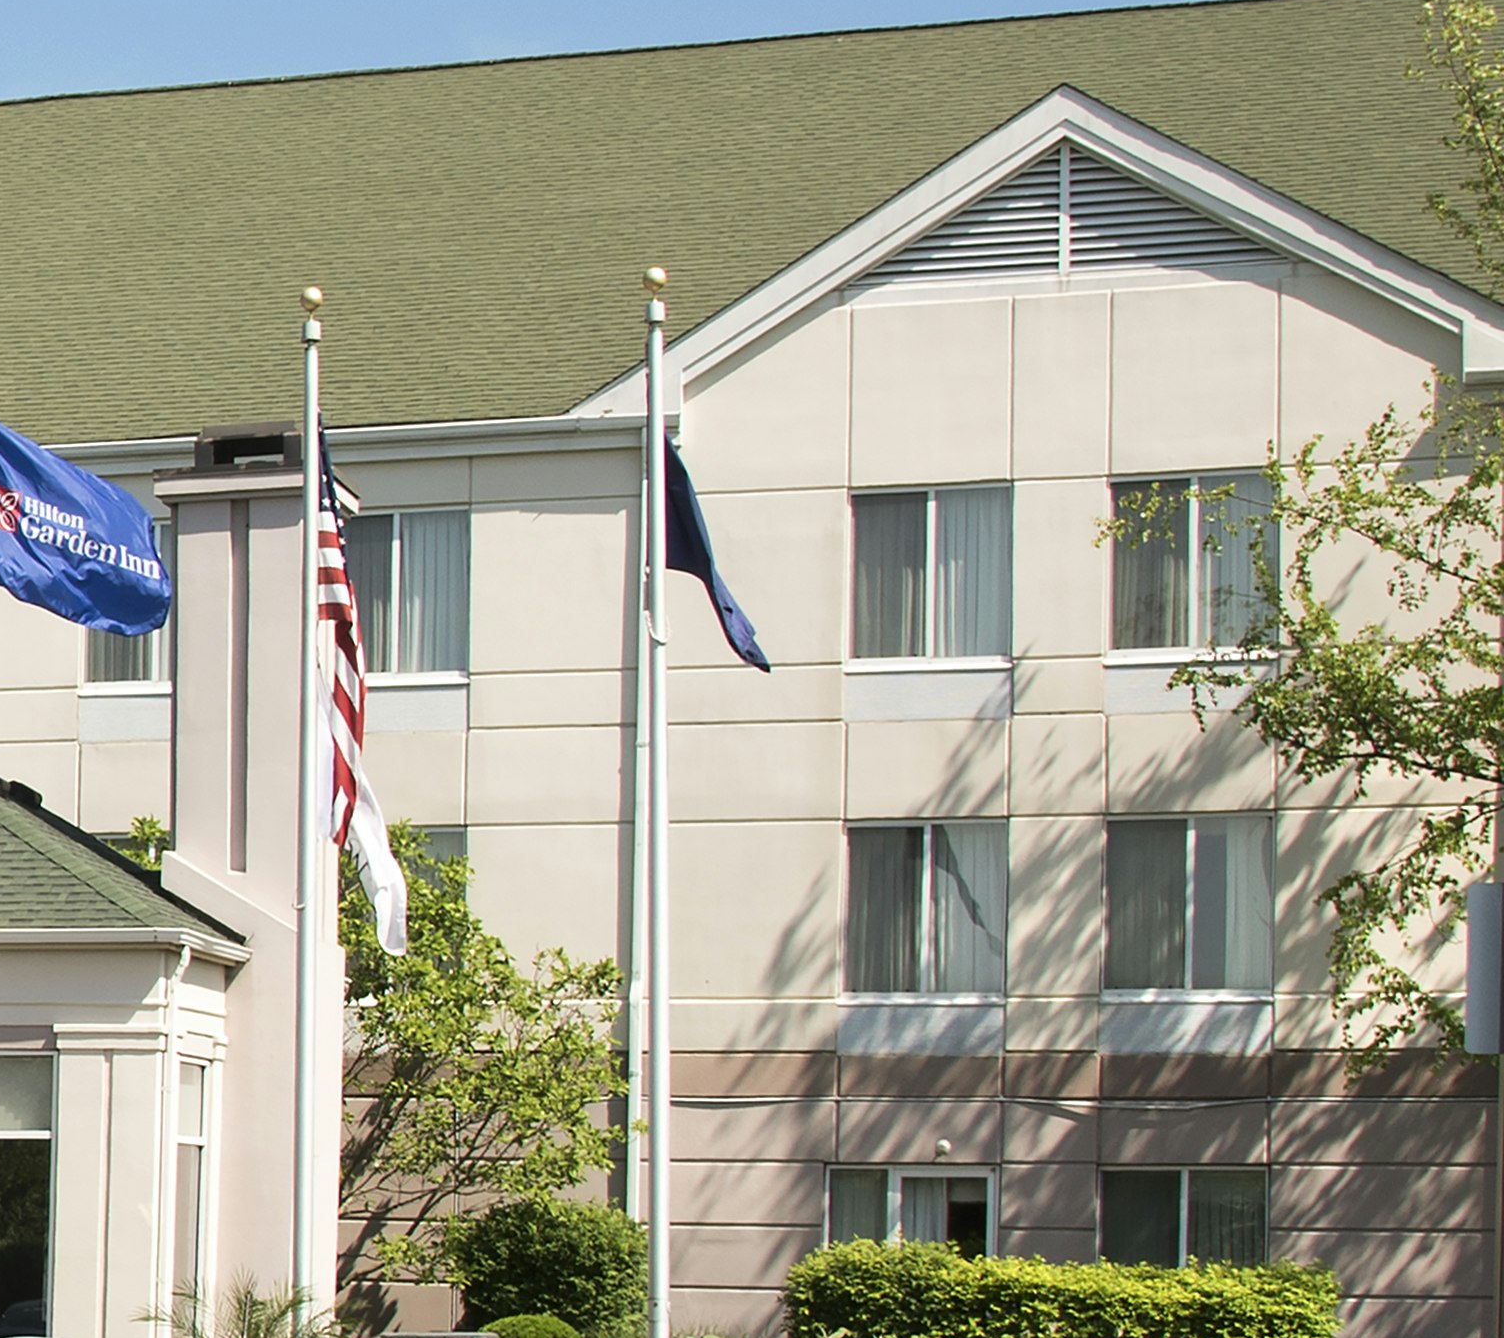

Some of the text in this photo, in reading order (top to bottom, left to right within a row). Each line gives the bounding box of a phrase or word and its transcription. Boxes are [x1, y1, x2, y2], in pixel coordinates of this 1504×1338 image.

[23, 495, 84, 530] Hilton
[20, 514, 161, 580] Garden Inn
